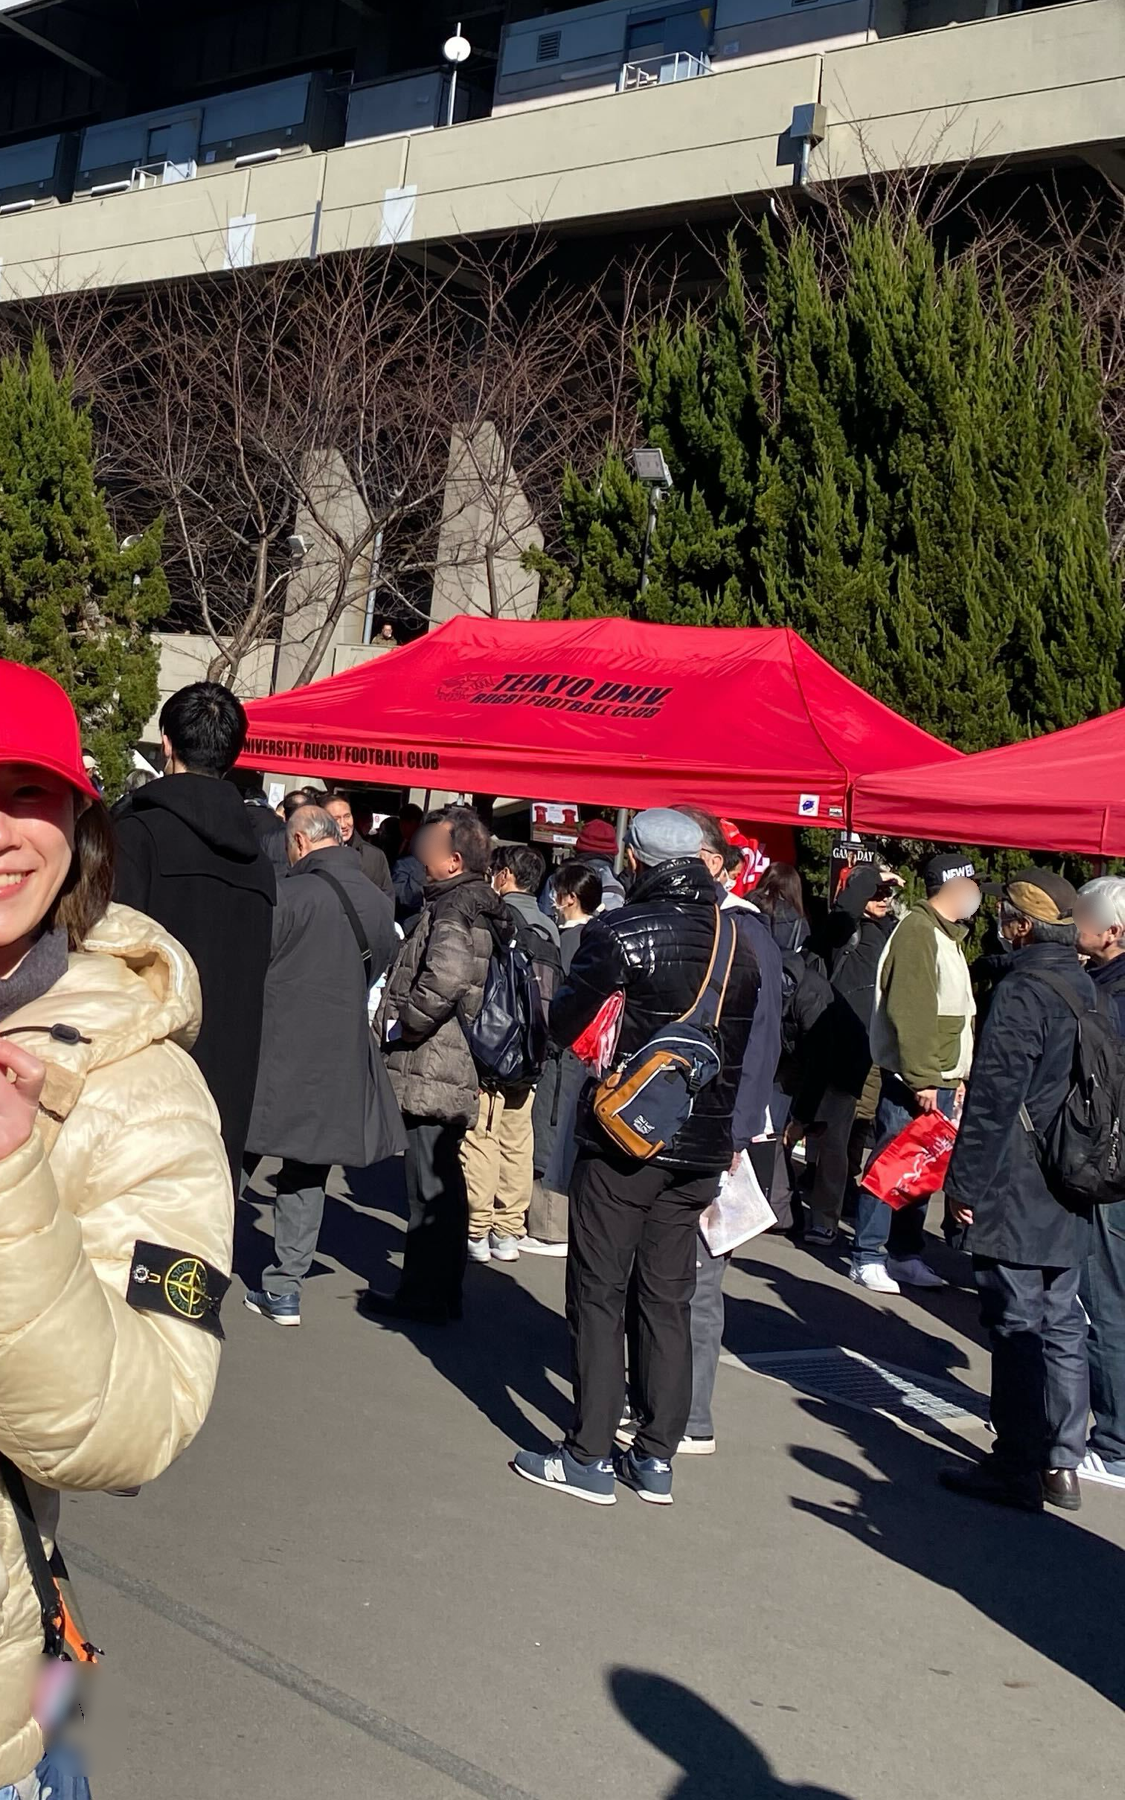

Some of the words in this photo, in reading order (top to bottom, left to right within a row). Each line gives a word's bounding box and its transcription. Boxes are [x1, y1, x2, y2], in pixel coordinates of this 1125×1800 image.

[490, 673, 595, 698] TEIKYO
[591, 681, 674, 706] UNIV.
[469, 693, 531, 705] RUGBY
[523, 695, 613, 716] FOOTBALL
[610, 706, 662, 719] CLUB
[242, 737, 302, 759] NIVERSITY
[303, 742, 343, 762] RUGBY
[344, 746, 405, 768] FOOTBALL
[407, 750, 440, 771] CLUB
[857, 850, 874, 862] DAY
[942, 866, 965, 882] NEW
[171, 1262, 194, 1281] STONE
[544, 1459, 567, 1482] N
